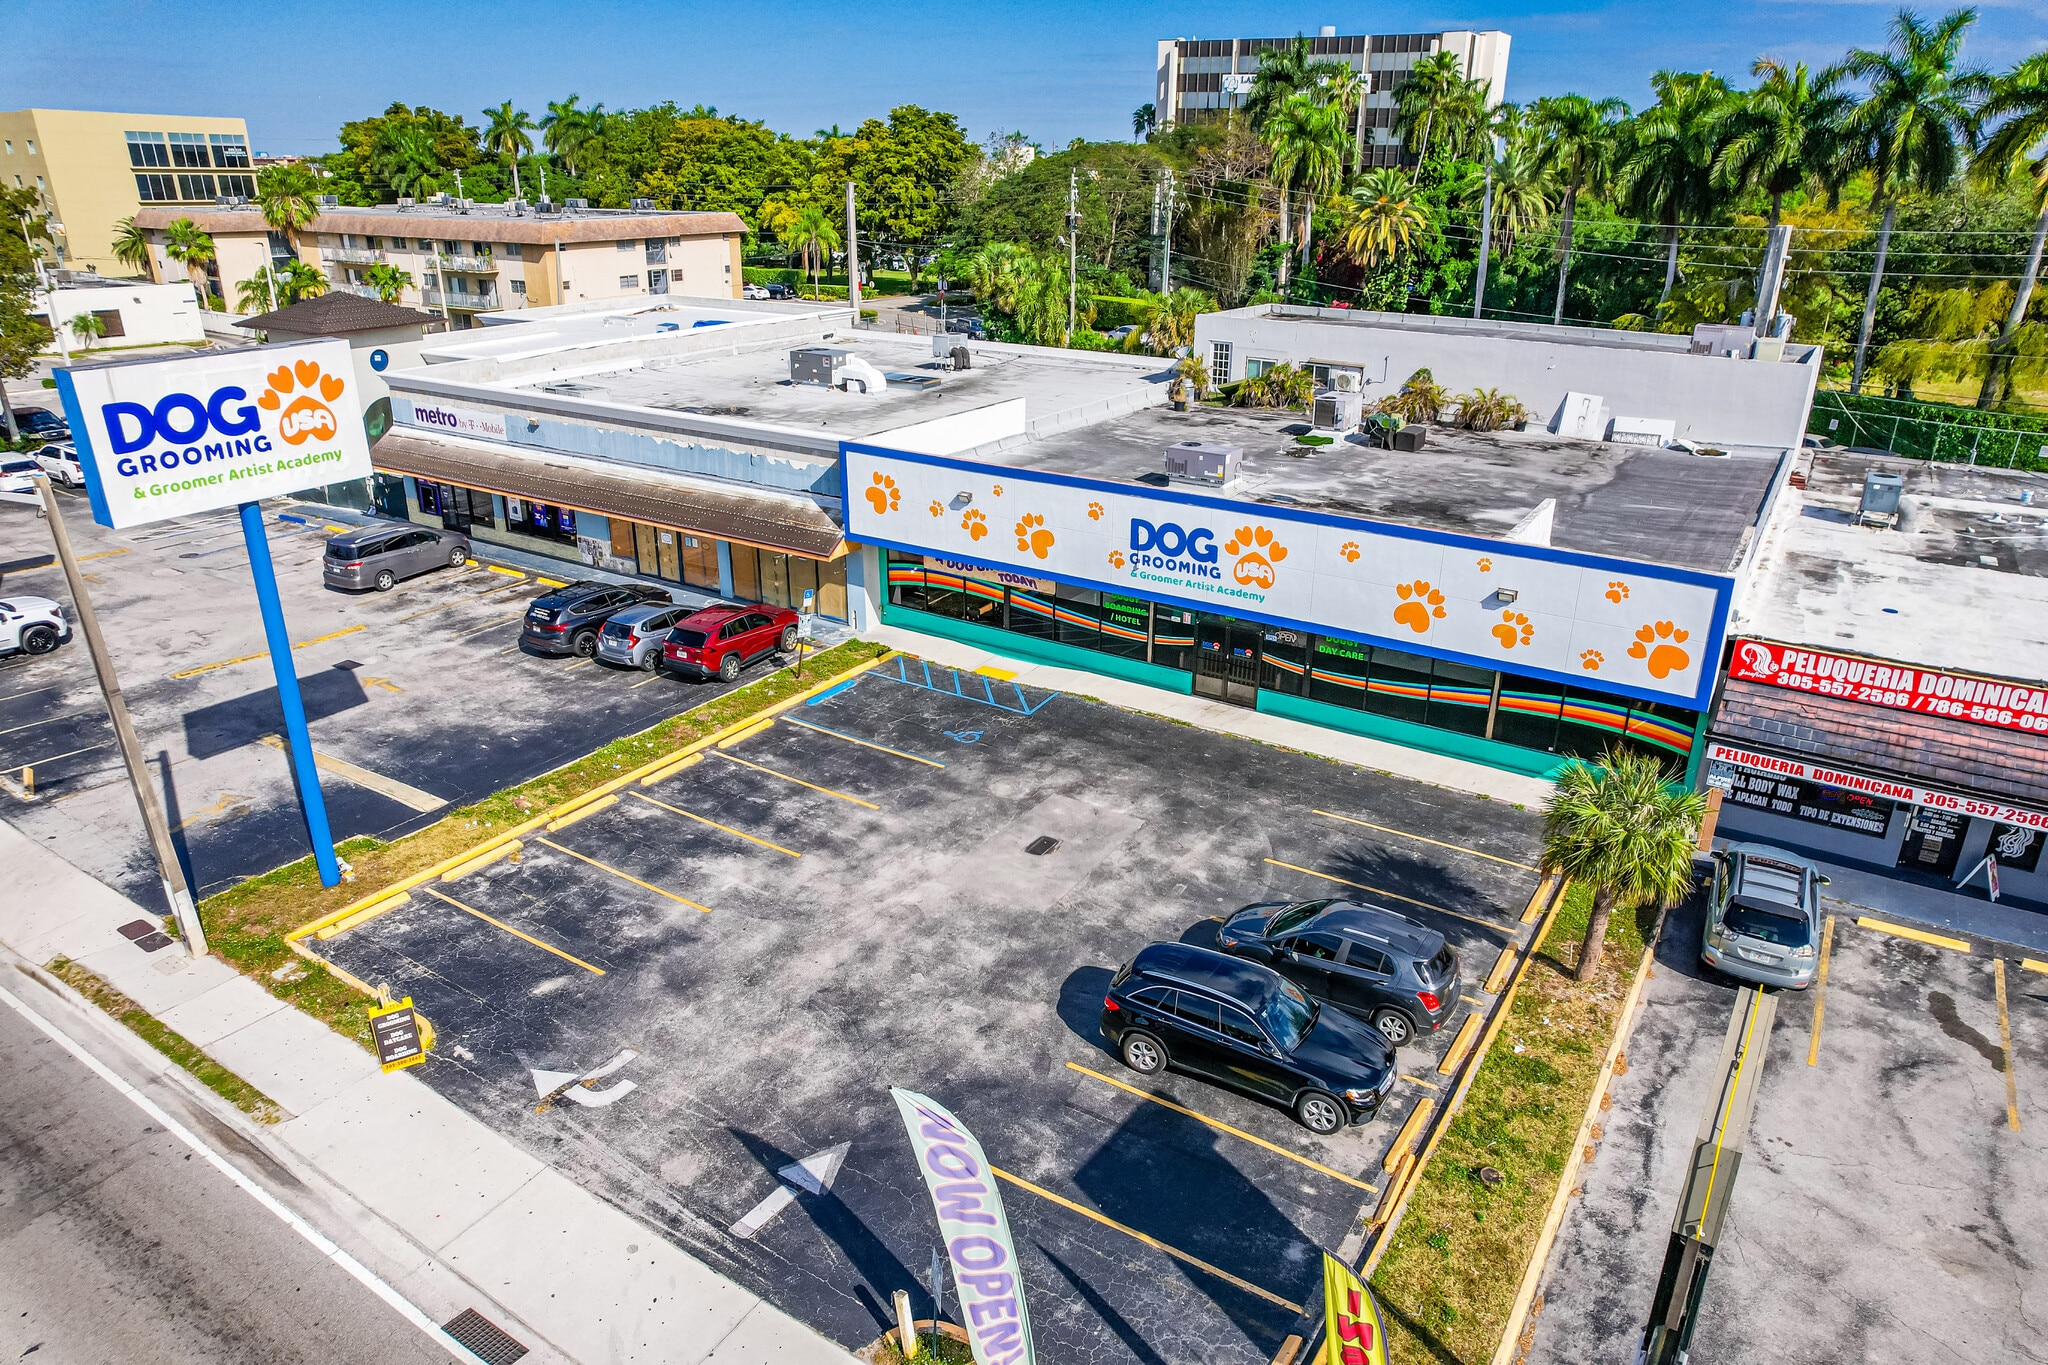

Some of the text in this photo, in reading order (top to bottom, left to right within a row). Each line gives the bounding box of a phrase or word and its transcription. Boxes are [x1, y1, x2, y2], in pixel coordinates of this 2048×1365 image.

[101, 385, 261, 455] DOG
[281, 409, 335, 437] USA
[414, 406, 458, 428] metro
[459, 418, 467, 432] by
[117, 435, 272, 477] GROOMING
[133, 449, 342, 499] & Groomer Artist Academy
[1130, 517, 1218, 564] DOG
[1129, 552, 1221, 579] GROOMING
[1236, 562, 1273, 583] USA
[997, 572, 1038, 590] TODAY!
[1131, 569, 1265, 604] & Groomer Artist Academy
[1104, 601, 1147, 616] BOARDING
[1115, 614, 1142, 626] HOTEL
[1319, 645, 1364, 661] DAY CARE
[1780, 649, 1915, 692] PELUQUERIA
[1777, 671, 1910, 707] 305-557-2586
[1912, 696, 1925, 709] /
[1715, 746, 1804, 777] PELUQUERIA
[1812, 768, 1914, 800] DOMINICANA
[1748, 777, 1775, 794] BODY
[1777, 783, 1800, 800] WAX
[1846, 793, 1873, 805] OPEN
[1735, 791, 1767, 807] APLICAN
[1771, 799, 1793, 813] TODO
[1800, 805, 1818, 819] TIPO
[1818, 809, 1830, 821] DE
[1831, 812, 1885, 833] EXTENSIONES
[377, 1015, 411, 1029] GROOMING
[386, 1013, 399, 1021] DOG
[383, 1032, 413, 1046] DAYCARE
[390, 1030, 404, 1038] DOG
[394, 1045, 408, 1054] DOG
[915, 1105, 999, 1228] NOW
